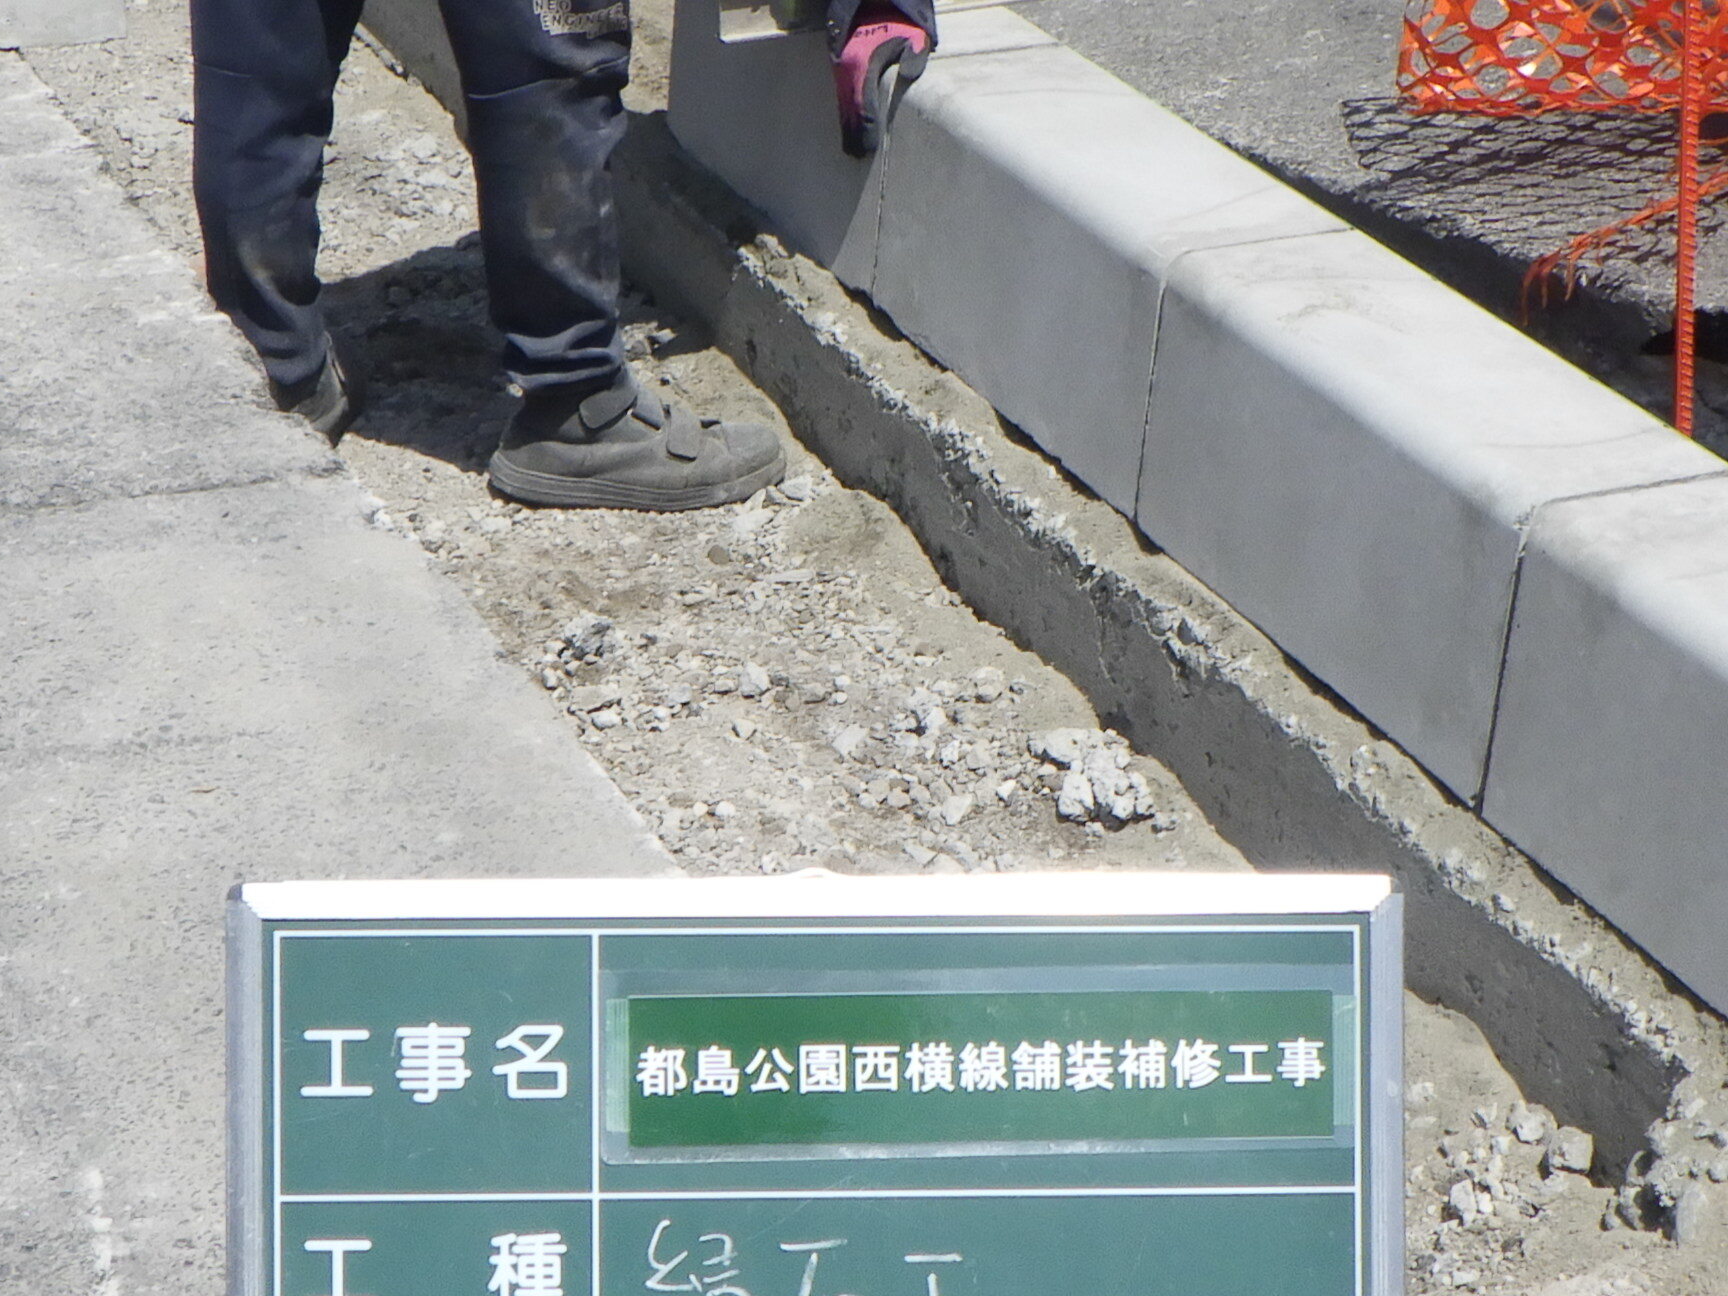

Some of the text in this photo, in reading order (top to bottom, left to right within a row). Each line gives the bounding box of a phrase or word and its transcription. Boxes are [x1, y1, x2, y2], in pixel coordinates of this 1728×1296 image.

[300, 1022, 568, 1103] 工事名
[635, 1036, 1327, 1098] 都島公園西横線舗装補修工事
